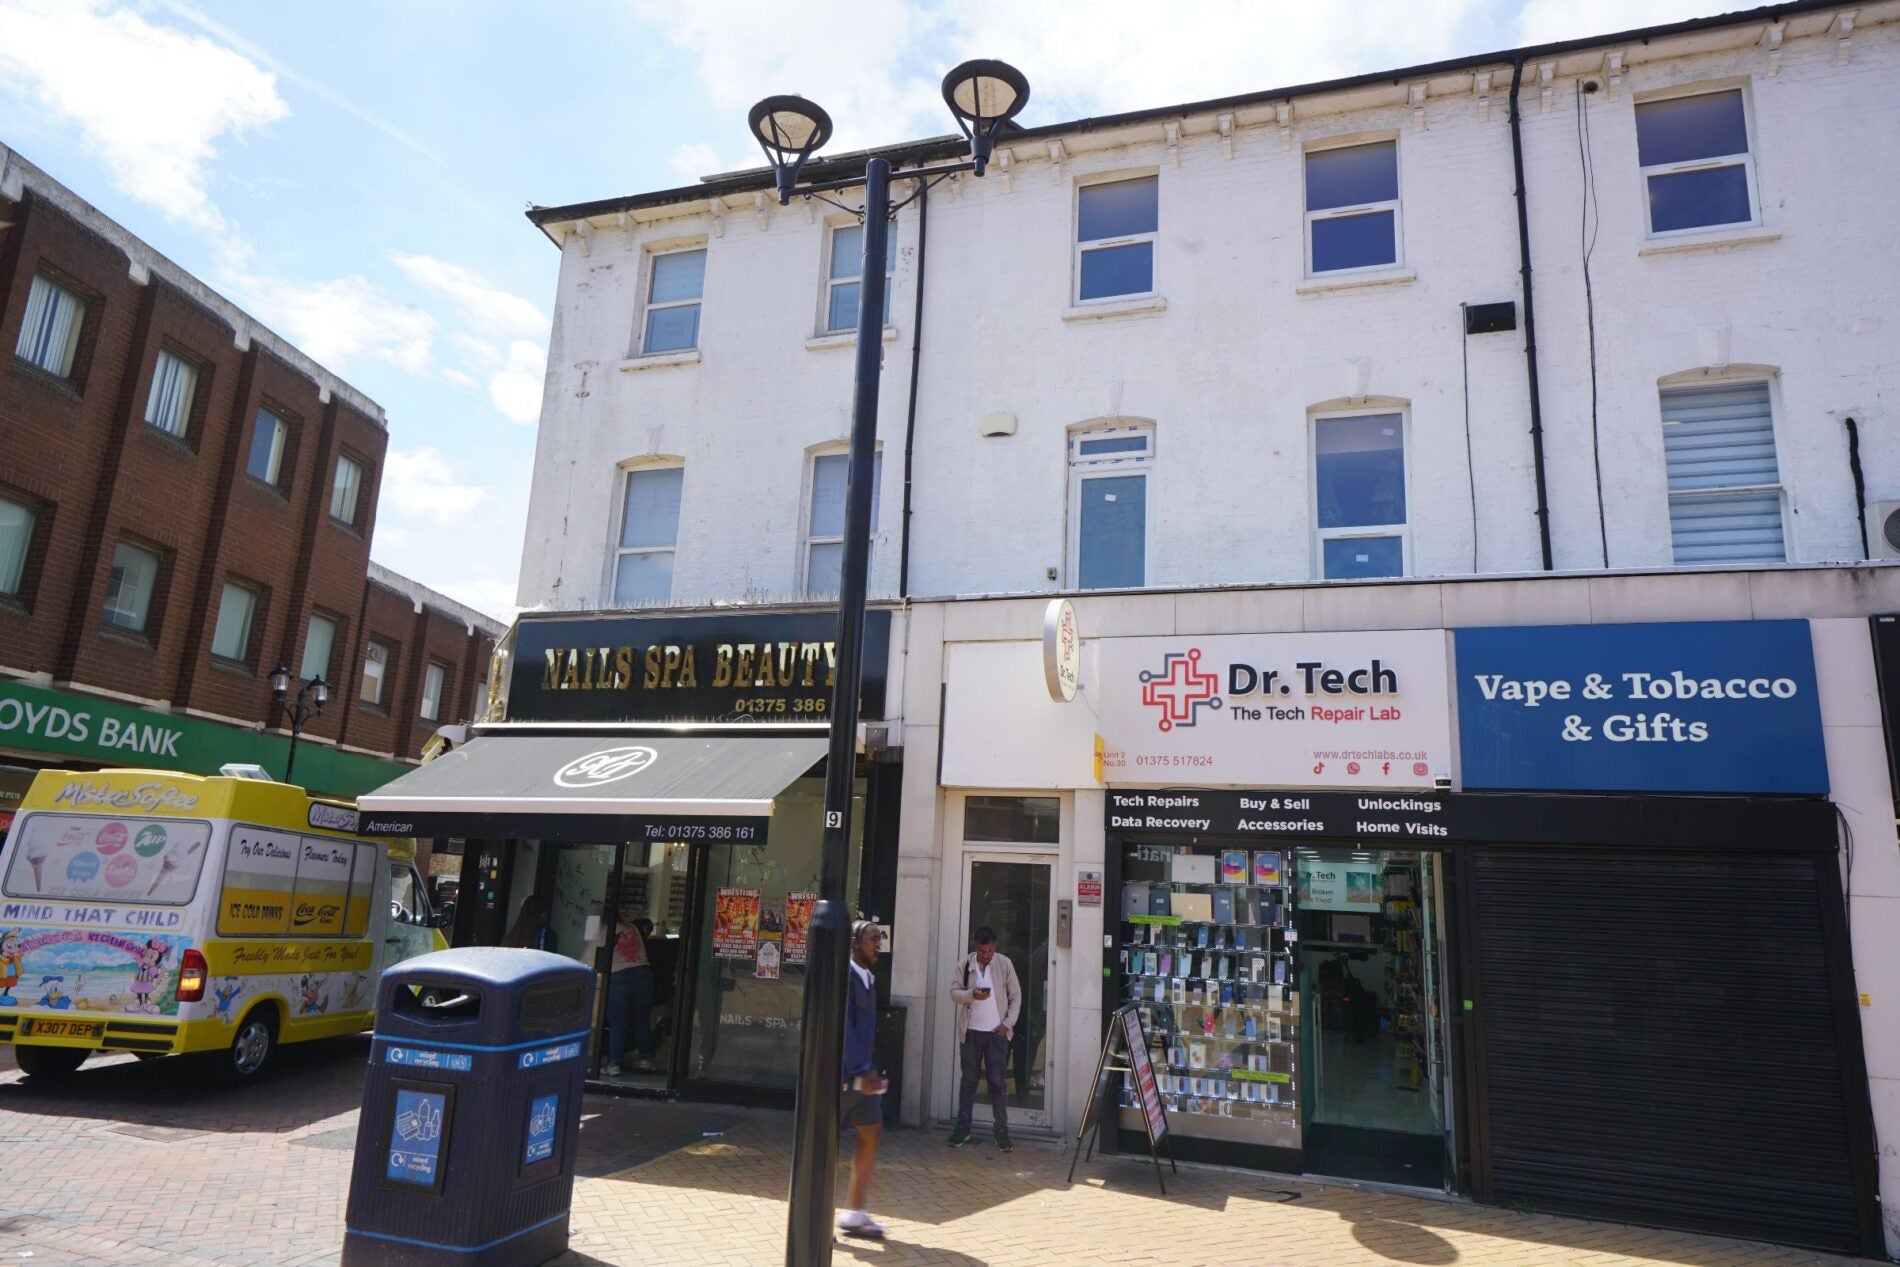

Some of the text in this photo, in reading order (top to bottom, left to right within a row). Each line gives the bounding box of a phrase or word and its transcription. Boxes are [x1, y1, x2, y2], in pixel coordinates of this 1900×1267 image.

[541, 641, 835, 690] NAILS SPA BEAUTY
[1474, 671, 1797, 707] Vape & Tobacco
[734, 698, 827, 713] 01375 386
[1230, 706, 1401, 724] The Tech Repair Lab
[0, 698, 183, 757] OYDS BANK
[1561, 712, 1709, 742] & Gifts
[1103, 751, 1126, 759] Unit 2
[1136, 755, 1213, 767] 01375 517824
[1313, 750, 1428, 762] www.drtechlabs.co.uk
[1113, 795, 1200, 809] Tech Repairs
[1240, 798, 1310, 811] Buy & Sell
[1358, 798, 1442, 813] Unlockings
[366, 820, 413, 833] American
[829, 813, 838, 827] 9
[1111, 816, 1211, 831] Data Recovery
[1237, 818, 1324, 832] Accessories
[645, 824, 755, 839] Tel: 01375 386 161
[1356, 821, 1448, 837] Home Visits
[252, 842, 265, 857] Our
[265, 842, 292, 860] Delicious
[304, 846, 348, 867] Flavours Today
[1316, 871, 1336, 880] Tech
[720, 888, 758, 898] WRESTLING
[3, 904, 180, 927] MIND THAT CHILD
[229, 903, 283, 921] ICE COLD DRINKS
[233, 946, 360, 965] Freshly Made Just For You!
[36, 1022, 93, 1036] X307 DEP
[720, 1014, 753, 1026] NAILS
[765, 1017, 787, 1029] SPA
